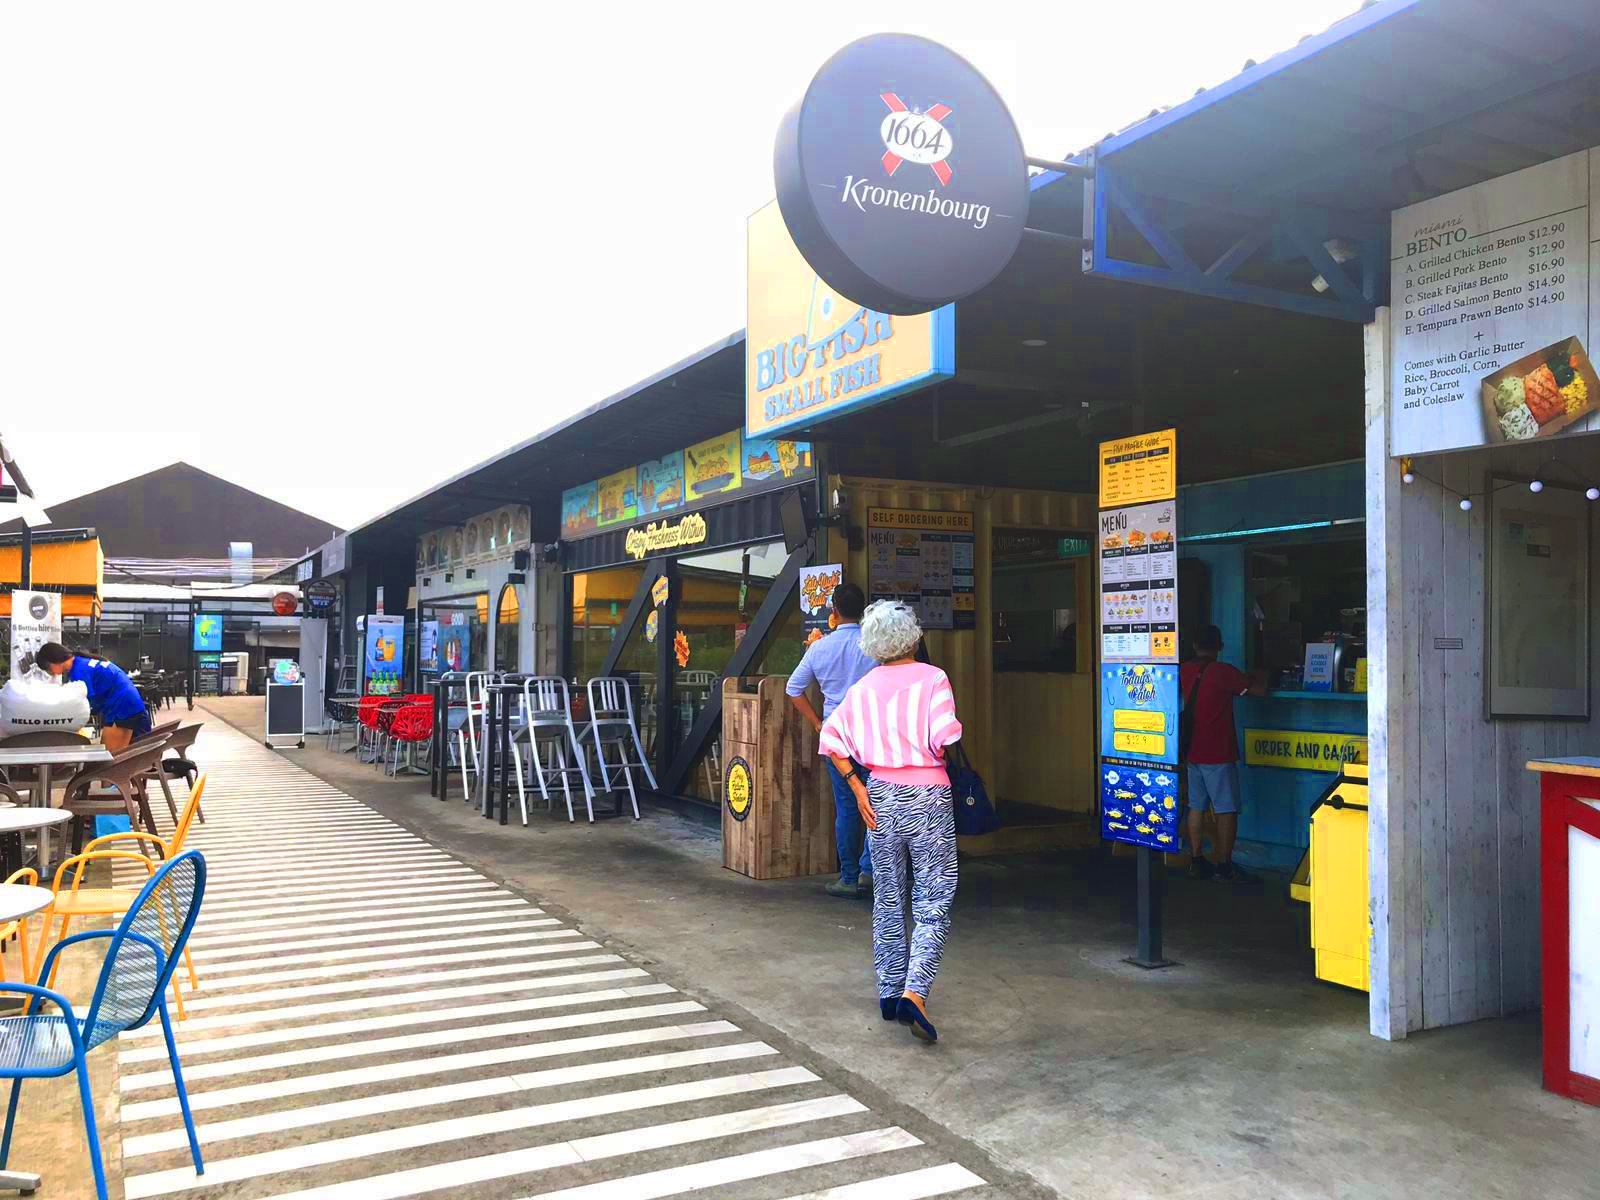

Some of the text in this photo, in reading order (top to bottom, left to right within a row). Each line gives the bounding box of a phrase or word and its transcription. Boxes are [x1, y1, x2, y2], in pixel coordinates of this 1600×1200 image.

[886, 116, 944, 155] 1664
[841, 175, 991, 230] Kronenbourg
[1414, 215, 1464, 238] miami
[1406, 227, 1468, 257] BENTO
[1406, 222, 1565, 274] A. Grilled Chicken Bento $12.90
[1405, 239, 1565, 289] B. Grilled Pork Bento $12.90
[1405, 256, 1565, 305] C. Steak Fajitas Bento $16.90
[1405, 273, 1565, 320] D. Grilled Salmon Bento $14.90
[1405, 290, 1565, 336] E. Tempura Prawn Bento $14.90
[756, 334, 808, 392] BIG
[1404, 340, 1526, 371] Comes with Garlic Butter
[1404, 359, 1501, 384] Rice, Broccoli, Corn,
[764, 352, 881, 422] SMALL FISH
[1403, 393, 1465, 410] and Coleslaw
[1404, 379, 1460, 397] Baby Carrot
[872, 512, 969, 527] SELF ORDERING HERE
[1101, 511, 1127, 535] MENU
[870, 530, 895, 546] MENU
[11, 717, 74, 726] HELLO KITTY
[1254, 739, 1292, 757] ORDER
[1295, 742, 1321, 759] AND
